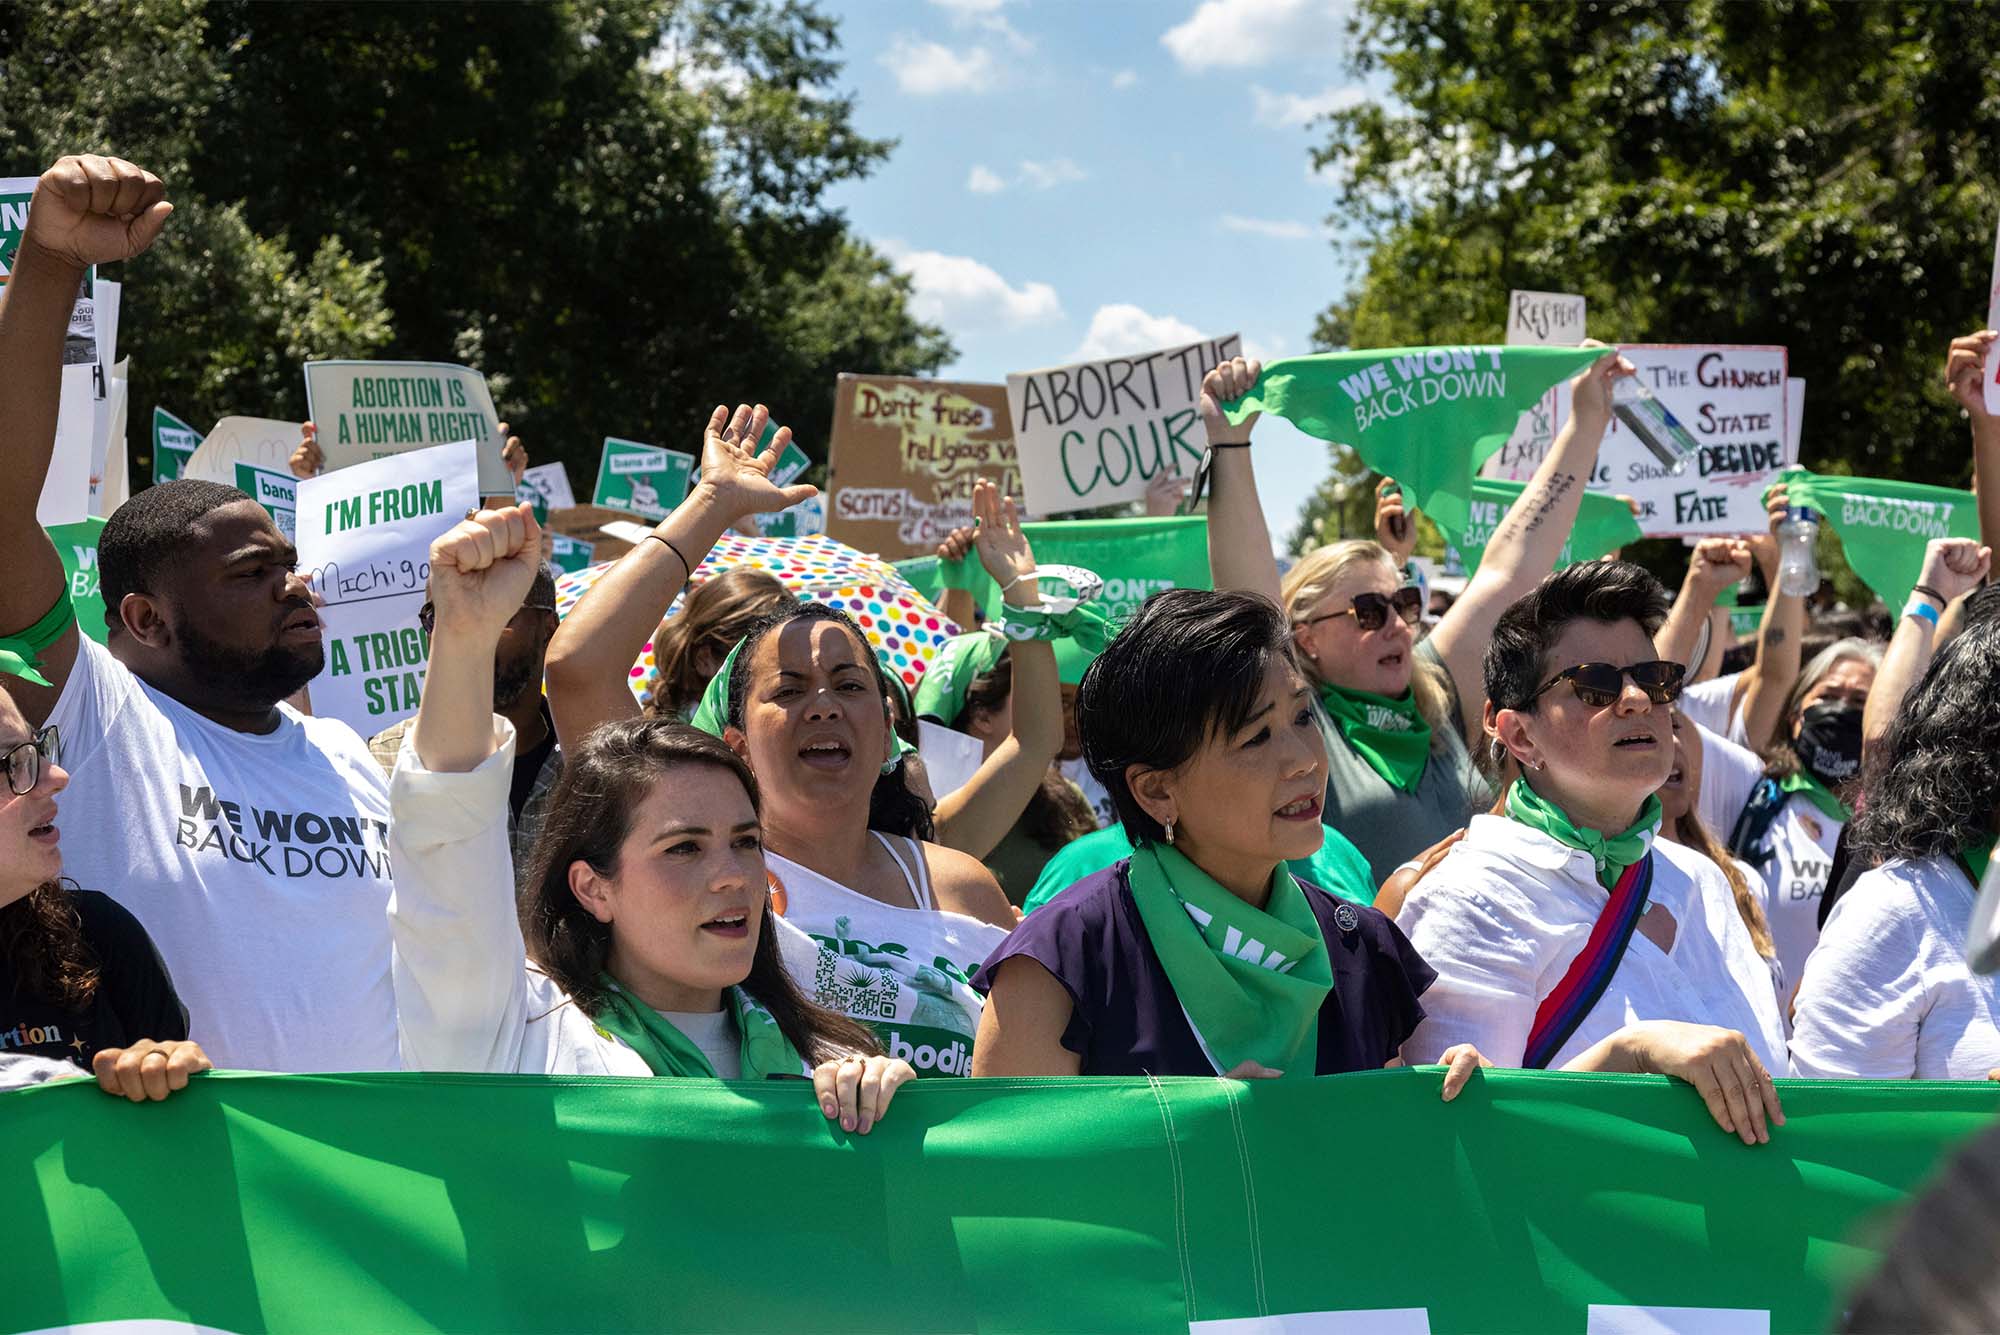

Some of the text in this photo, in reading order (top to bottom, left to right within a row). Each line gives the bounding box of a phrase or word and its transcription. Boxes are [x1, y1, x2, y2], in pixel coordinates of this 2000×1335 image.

[1338, 346, 1503, 404] WE WON'T
[1646, 352, 1782, 389] THE CHURCH
[353, 377, 466, 408] ABORTION IS
[931, 394, 984, 426] fuse
[1021, 352, 1164, 432] ABORT
[1354, 371, 1506, 432] BACK DOWN
[339, 411, 488, 444] A HUMAN RIGHT!
[1697, 403, 1771, 435] STATE
[1061, 408, 1204, 497] COUR
[1699, 441, 1785, 478] DECIDE
[261, 480, 295, 502] bans
[325, 480, 443, 535] I'M FROM
[840, 493, 900, 515] SCOTUS
[1675, 490, 1727, 525] FATE
[1842, 504, 1890, 528] BACK
[1893, 509, 1950, 539] DOWN
[71, 571, 101, 598] BA
[331, 639, 351, 677] A
[364, 670, 426, 715] STA
[179, 783, 388, 850] WE WON'T
[176, 817, 276, 876] BACK
[1791, 881, 1824, 900] BA
[0, 1022, 62, 1049] rtion
